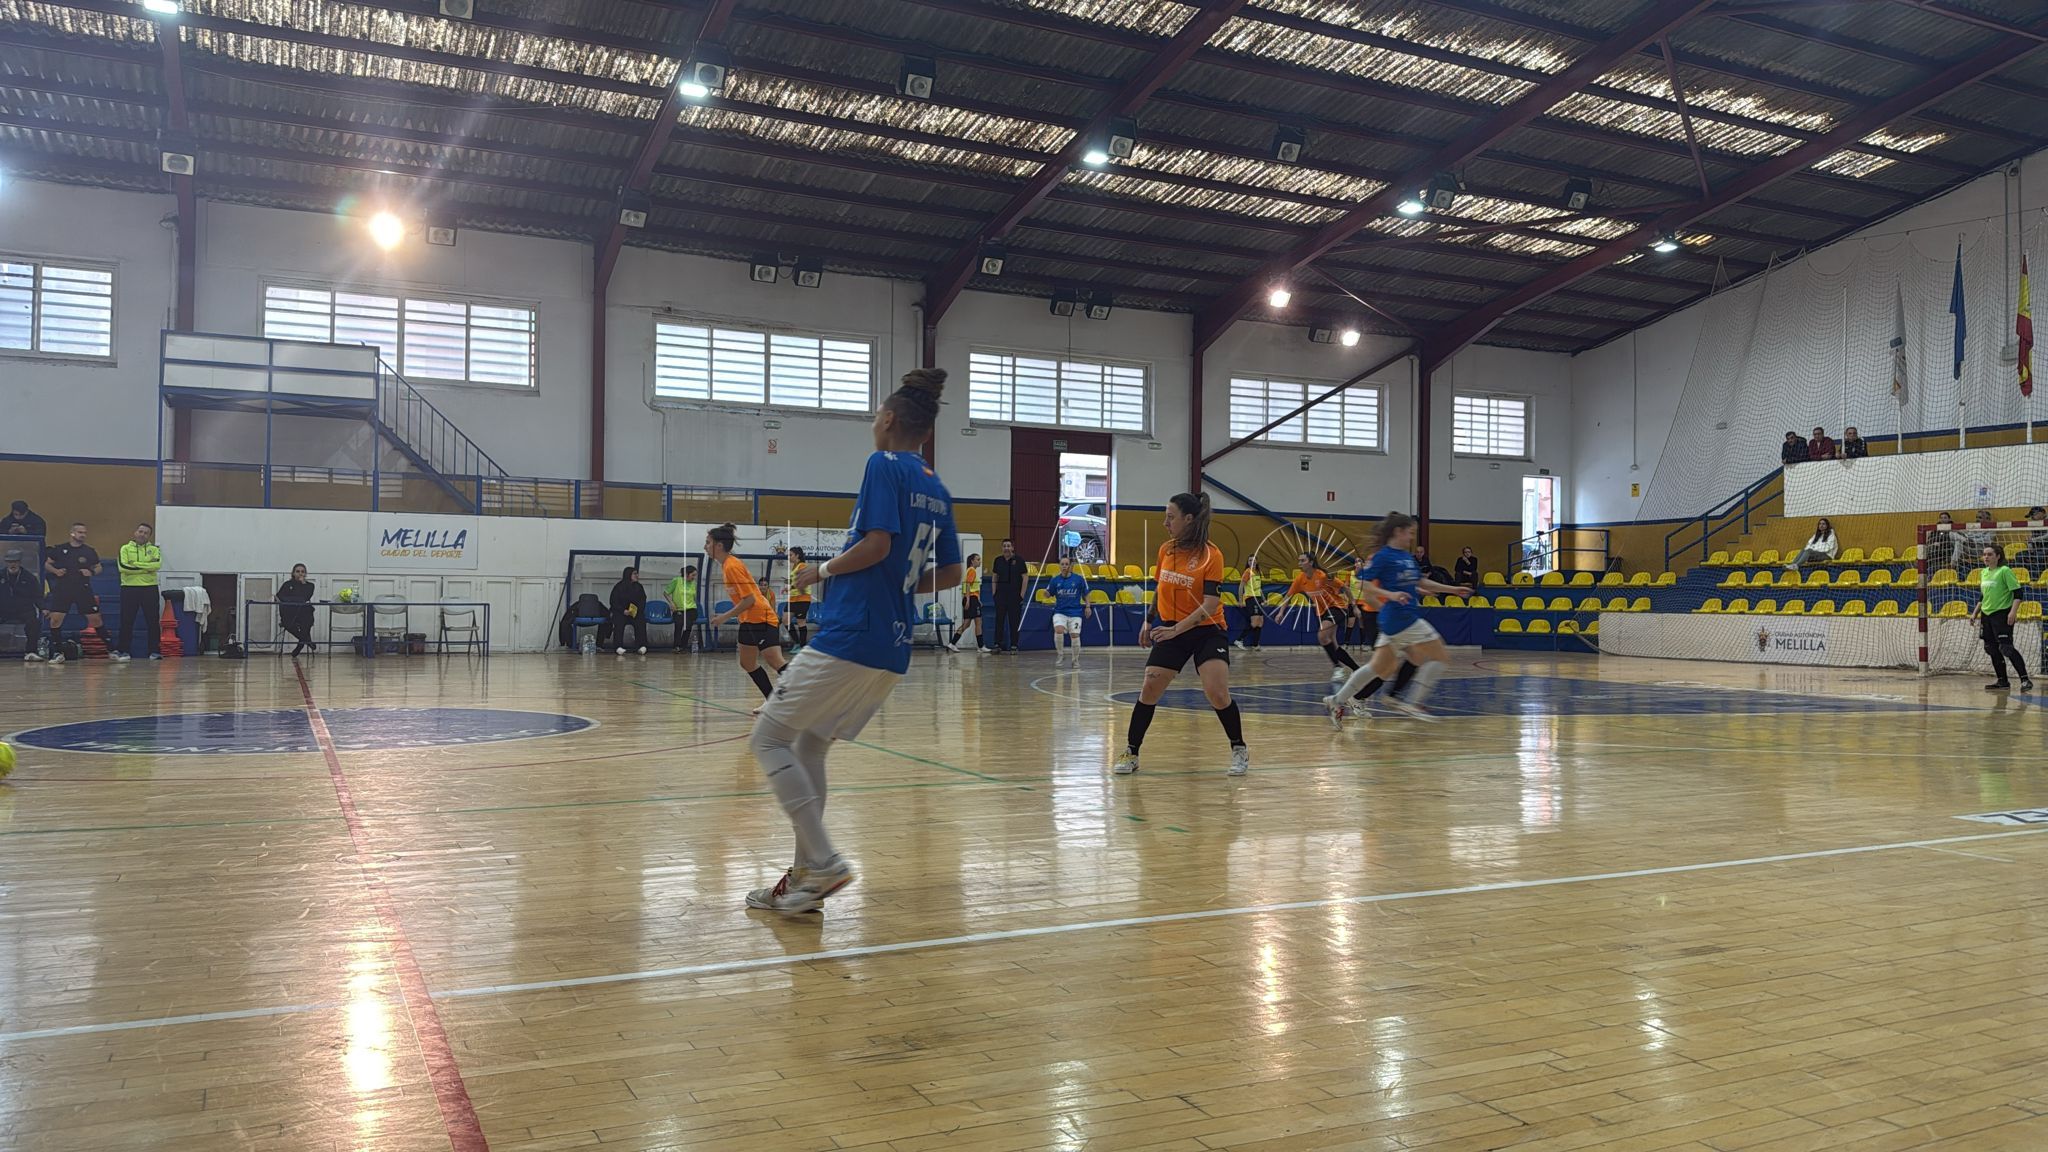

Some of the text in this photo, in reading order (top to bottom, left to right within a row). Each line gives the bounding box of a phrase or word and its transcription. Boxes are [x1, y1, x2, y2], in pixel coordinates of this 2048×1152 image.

[381, 528, 467, 549] MELILLA
[381, 549, 464, 559] CIUDAD DEL DEPORTE
[1776, 638, 1826, 651] MELILLA
